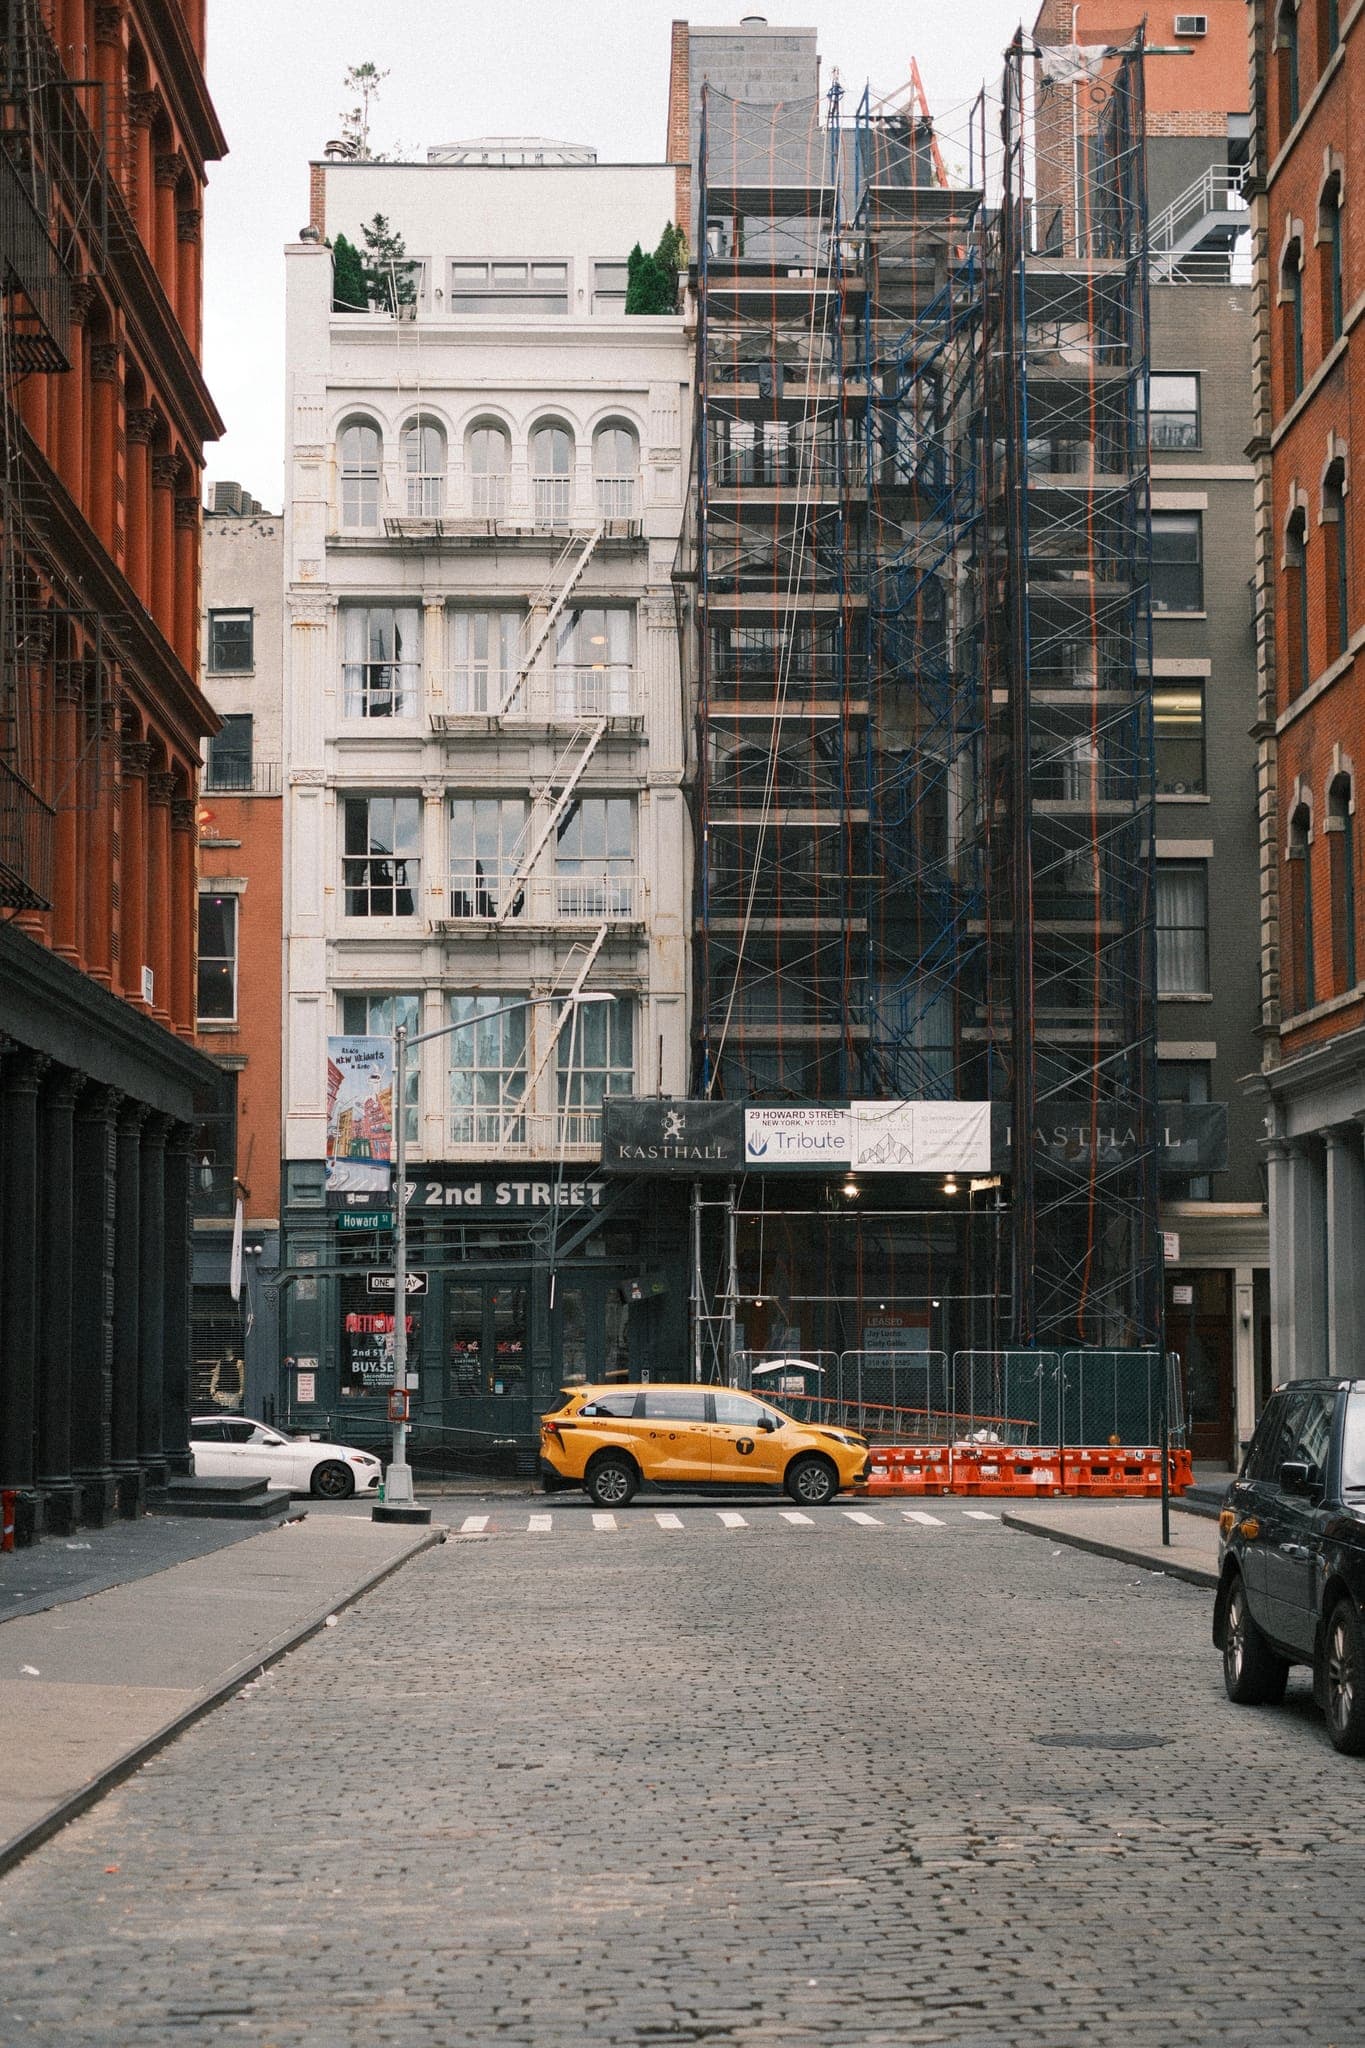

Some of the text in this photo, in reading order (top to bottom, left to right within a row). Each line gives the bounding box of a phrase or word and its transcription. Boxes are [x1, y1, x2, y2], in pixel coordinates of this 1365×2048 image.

[750, 1110, 845, 1119] 29 HOWARD STREET
[775, 1131, 845, 1149] Tribute
[620, 1145, 728, 1159] KASTHALL
[425, 1183, 482, 1205] 2nd
[495, 1182, 605, 1205] STREET
[343, 1214, 378, 1227] Howard
[374, 1278, 390, 1287] ONE
